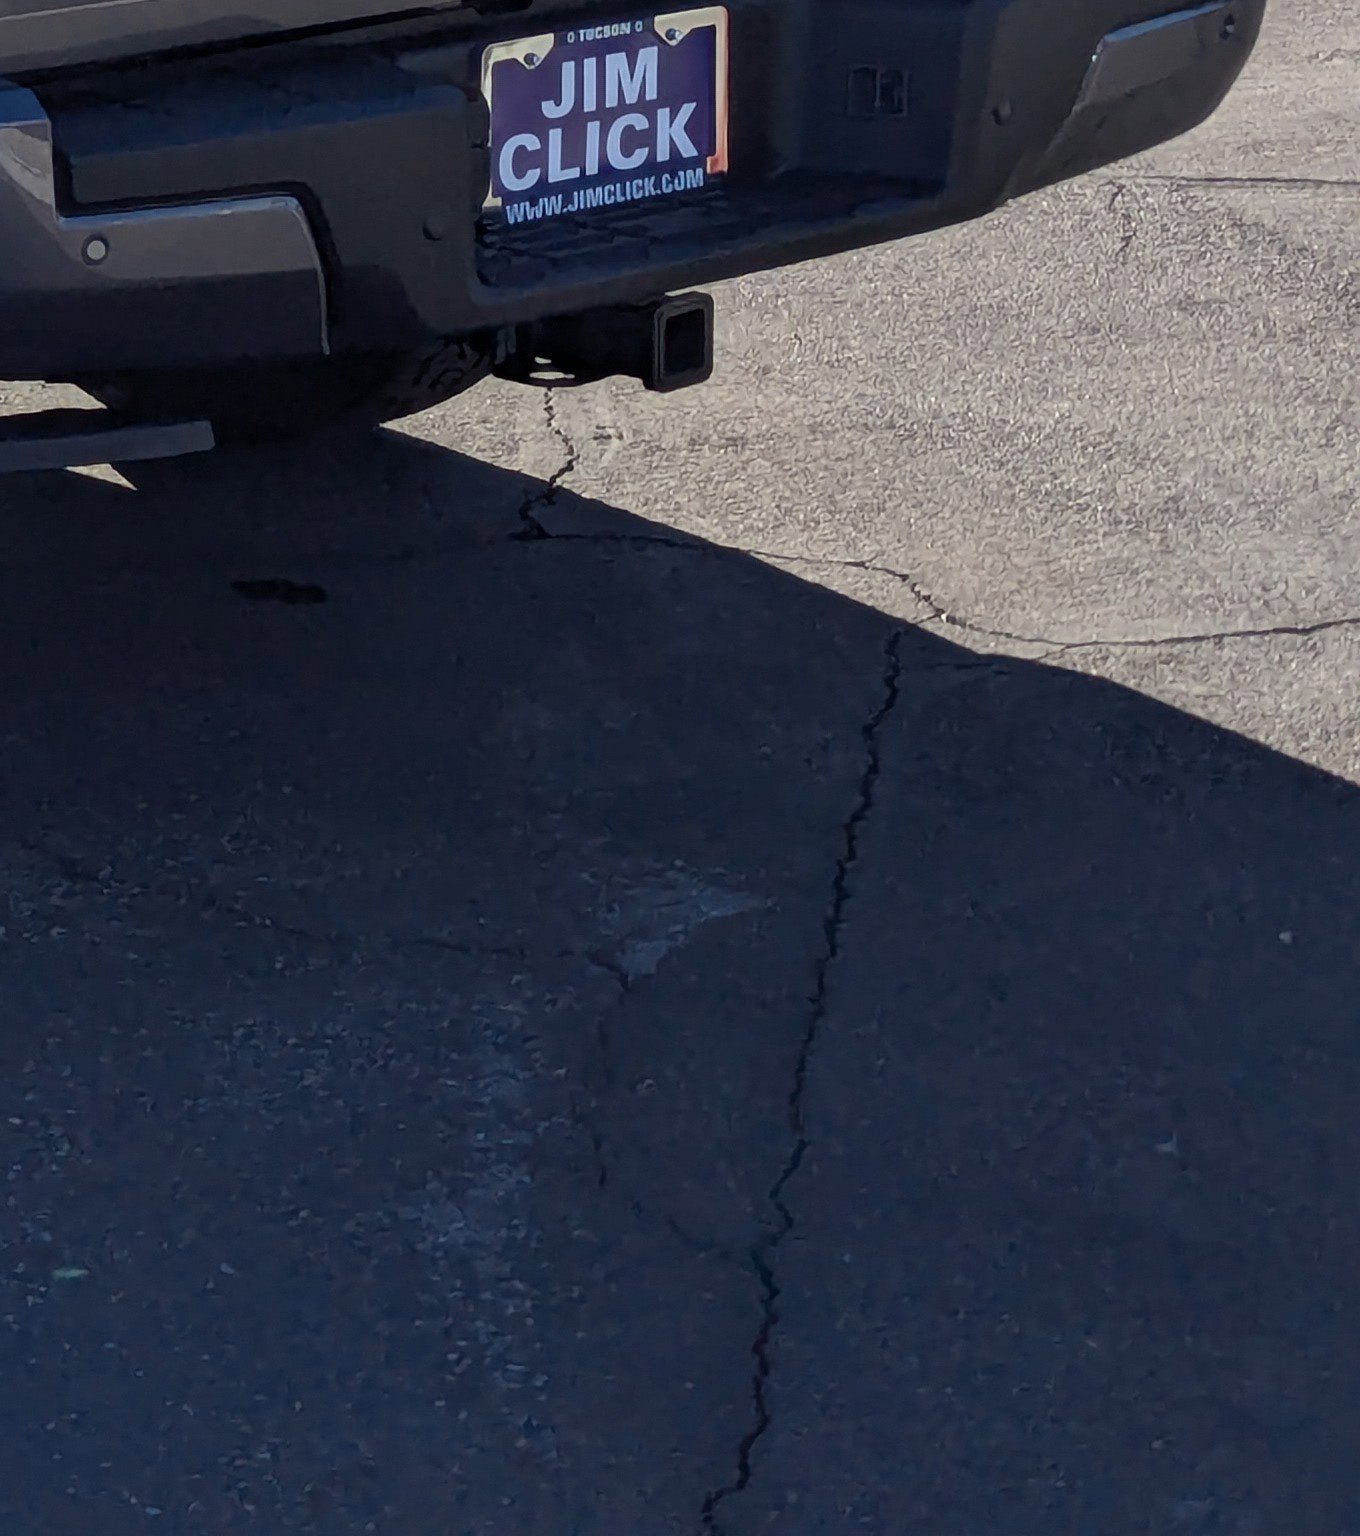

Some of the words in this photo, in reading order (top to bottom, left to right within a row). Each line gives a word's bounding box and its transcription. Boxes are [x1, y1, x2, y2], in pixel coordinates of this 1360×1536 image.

[540, 45, 659, 120] JIM
[498, 101, 700, 193] CLICK
[505, 167, 705, 225] WWW.JIMCLICK.COM
